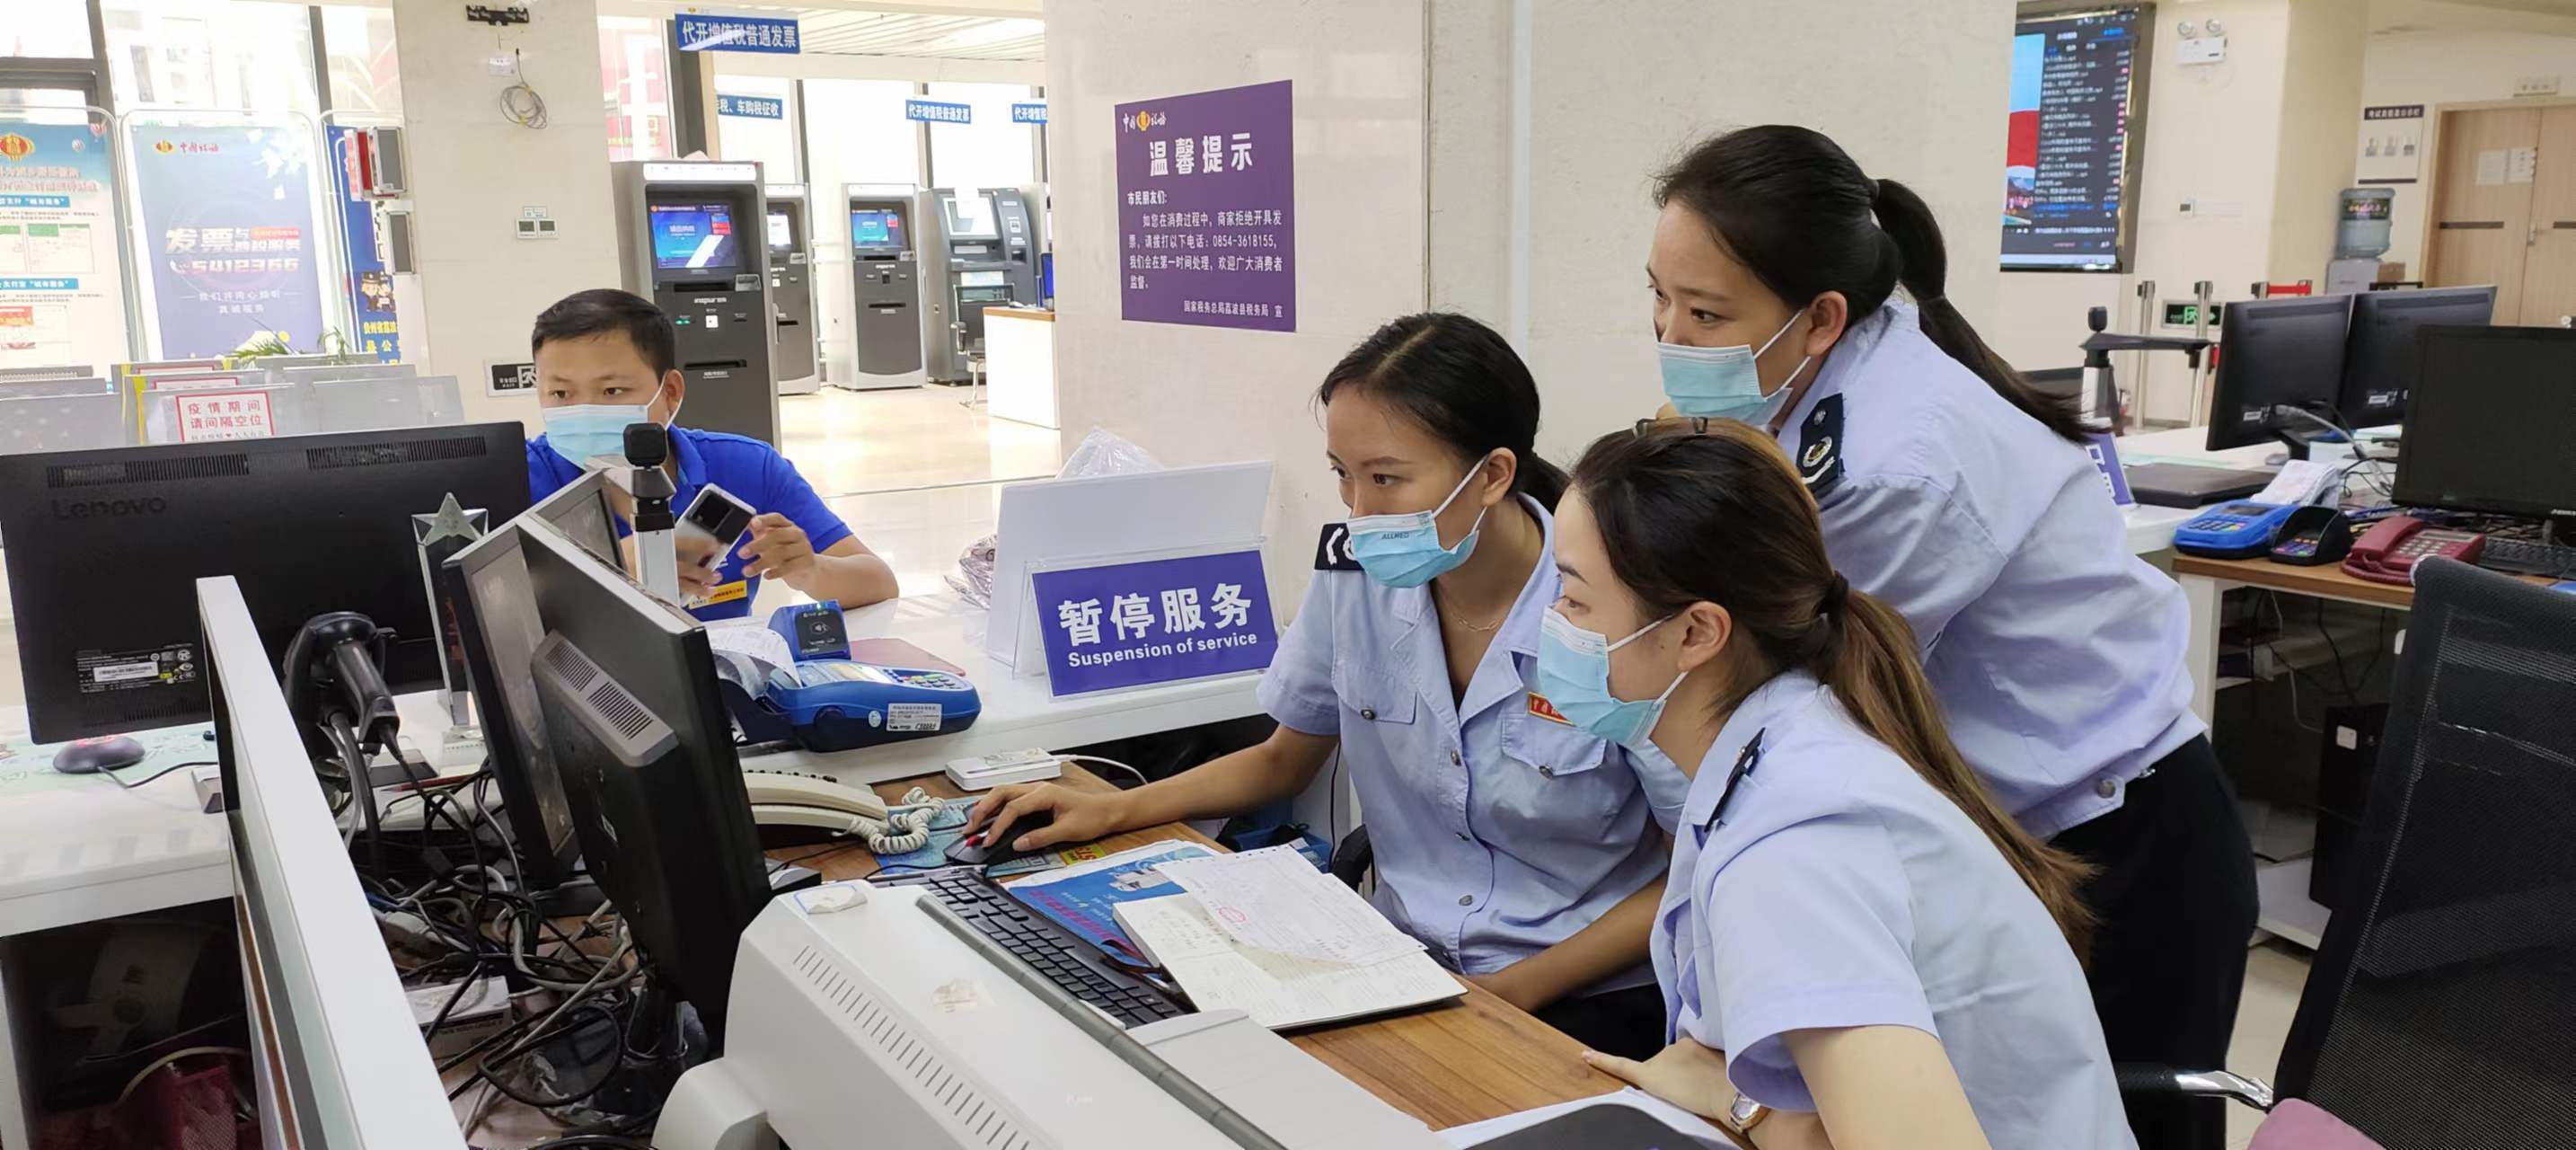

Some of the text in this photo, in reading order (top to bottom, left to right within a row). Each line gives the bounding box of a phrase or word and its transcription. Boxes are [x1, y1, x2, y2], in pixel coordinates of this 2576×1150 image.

[682, 20, 797, 49] 代开增值税普通发票
[1149, 132, 1254, 177] 温馨提示
[190, 258, 300, 274] 5412366
[188, 399, 261, 416] 疫情期间
[190, 415, 263, 430] 请间隔空位
[52, 494, 168, 521] Lenovo
[1056, 582, 1252, 648] 暂停服务
[1067, 632, 1258, 668] Suspension of service
